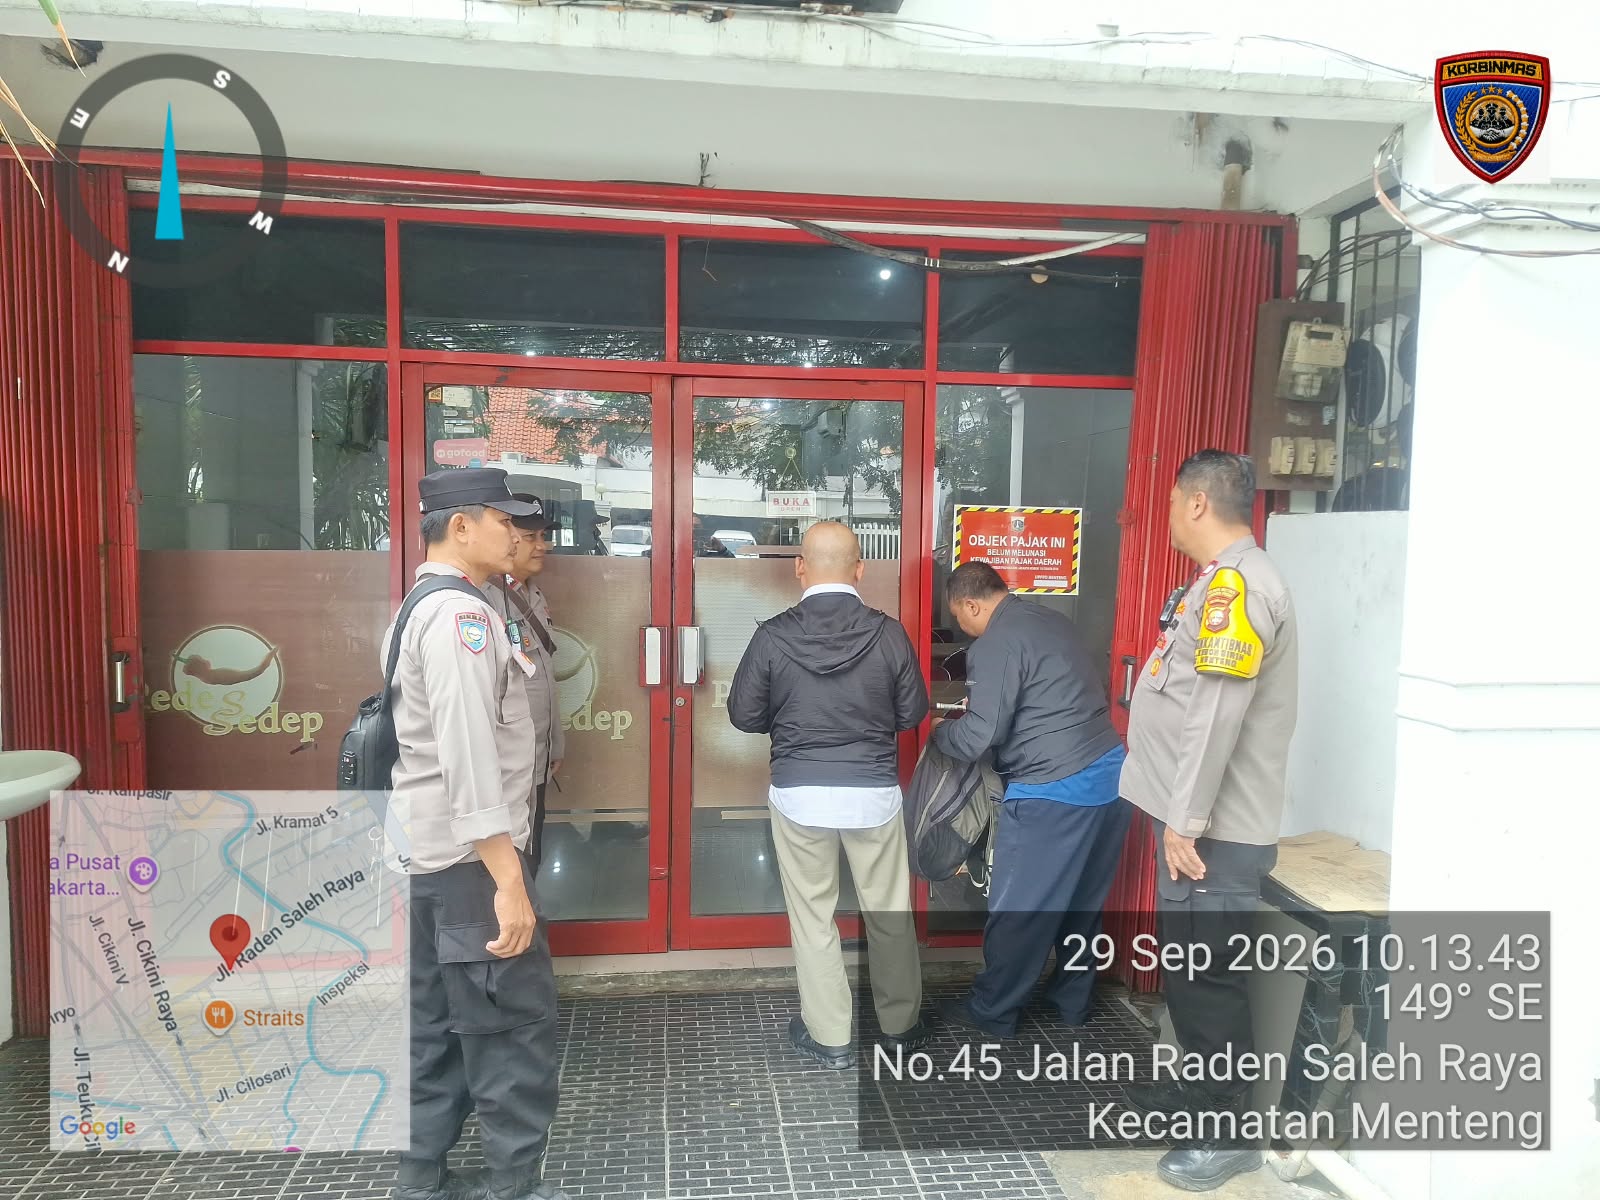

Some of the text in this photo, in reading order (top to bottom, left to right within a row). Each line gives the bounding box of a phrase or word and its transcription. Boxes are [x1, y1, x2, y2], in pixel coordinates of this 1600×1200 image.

[447, 449, 485, 459] gofood
[773, 498, 810, 506] BUKA
[968, 534, 1066, 549] OBJEK PAJAK INI
[987, 548, 1046, 557] BELUM MELUNASI
[1010, 557, 1033, 565] PAJAK
[1034, 558, 1062, 566] DAERAH
[203, 702, 324, 742] Sedep
[562, 701, 633, 740] edep
